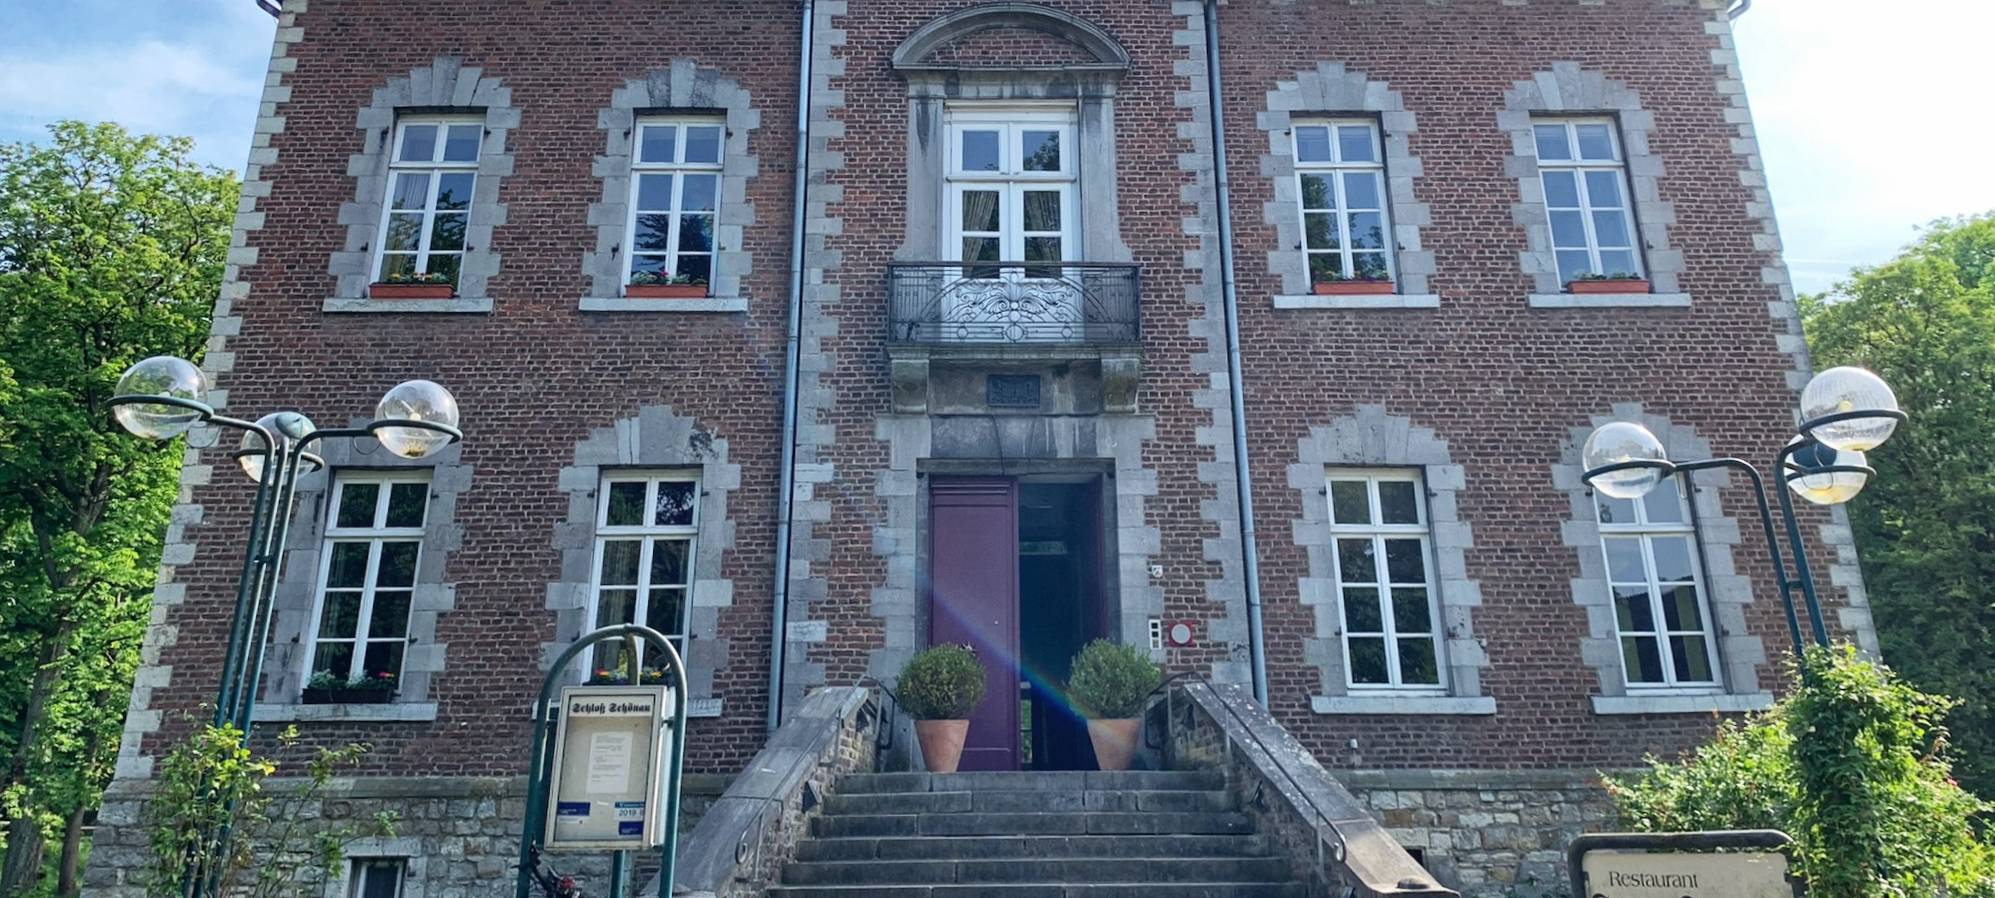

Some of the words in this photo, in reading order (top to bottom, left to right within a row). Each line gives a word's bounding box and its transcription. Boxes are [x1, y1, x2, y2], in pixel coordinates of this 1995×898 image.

[572, 703, 605, 714] Schloß
[609, 702, 650, 713] Schönau
[1609, 871, 1698, 888] Restaurant
